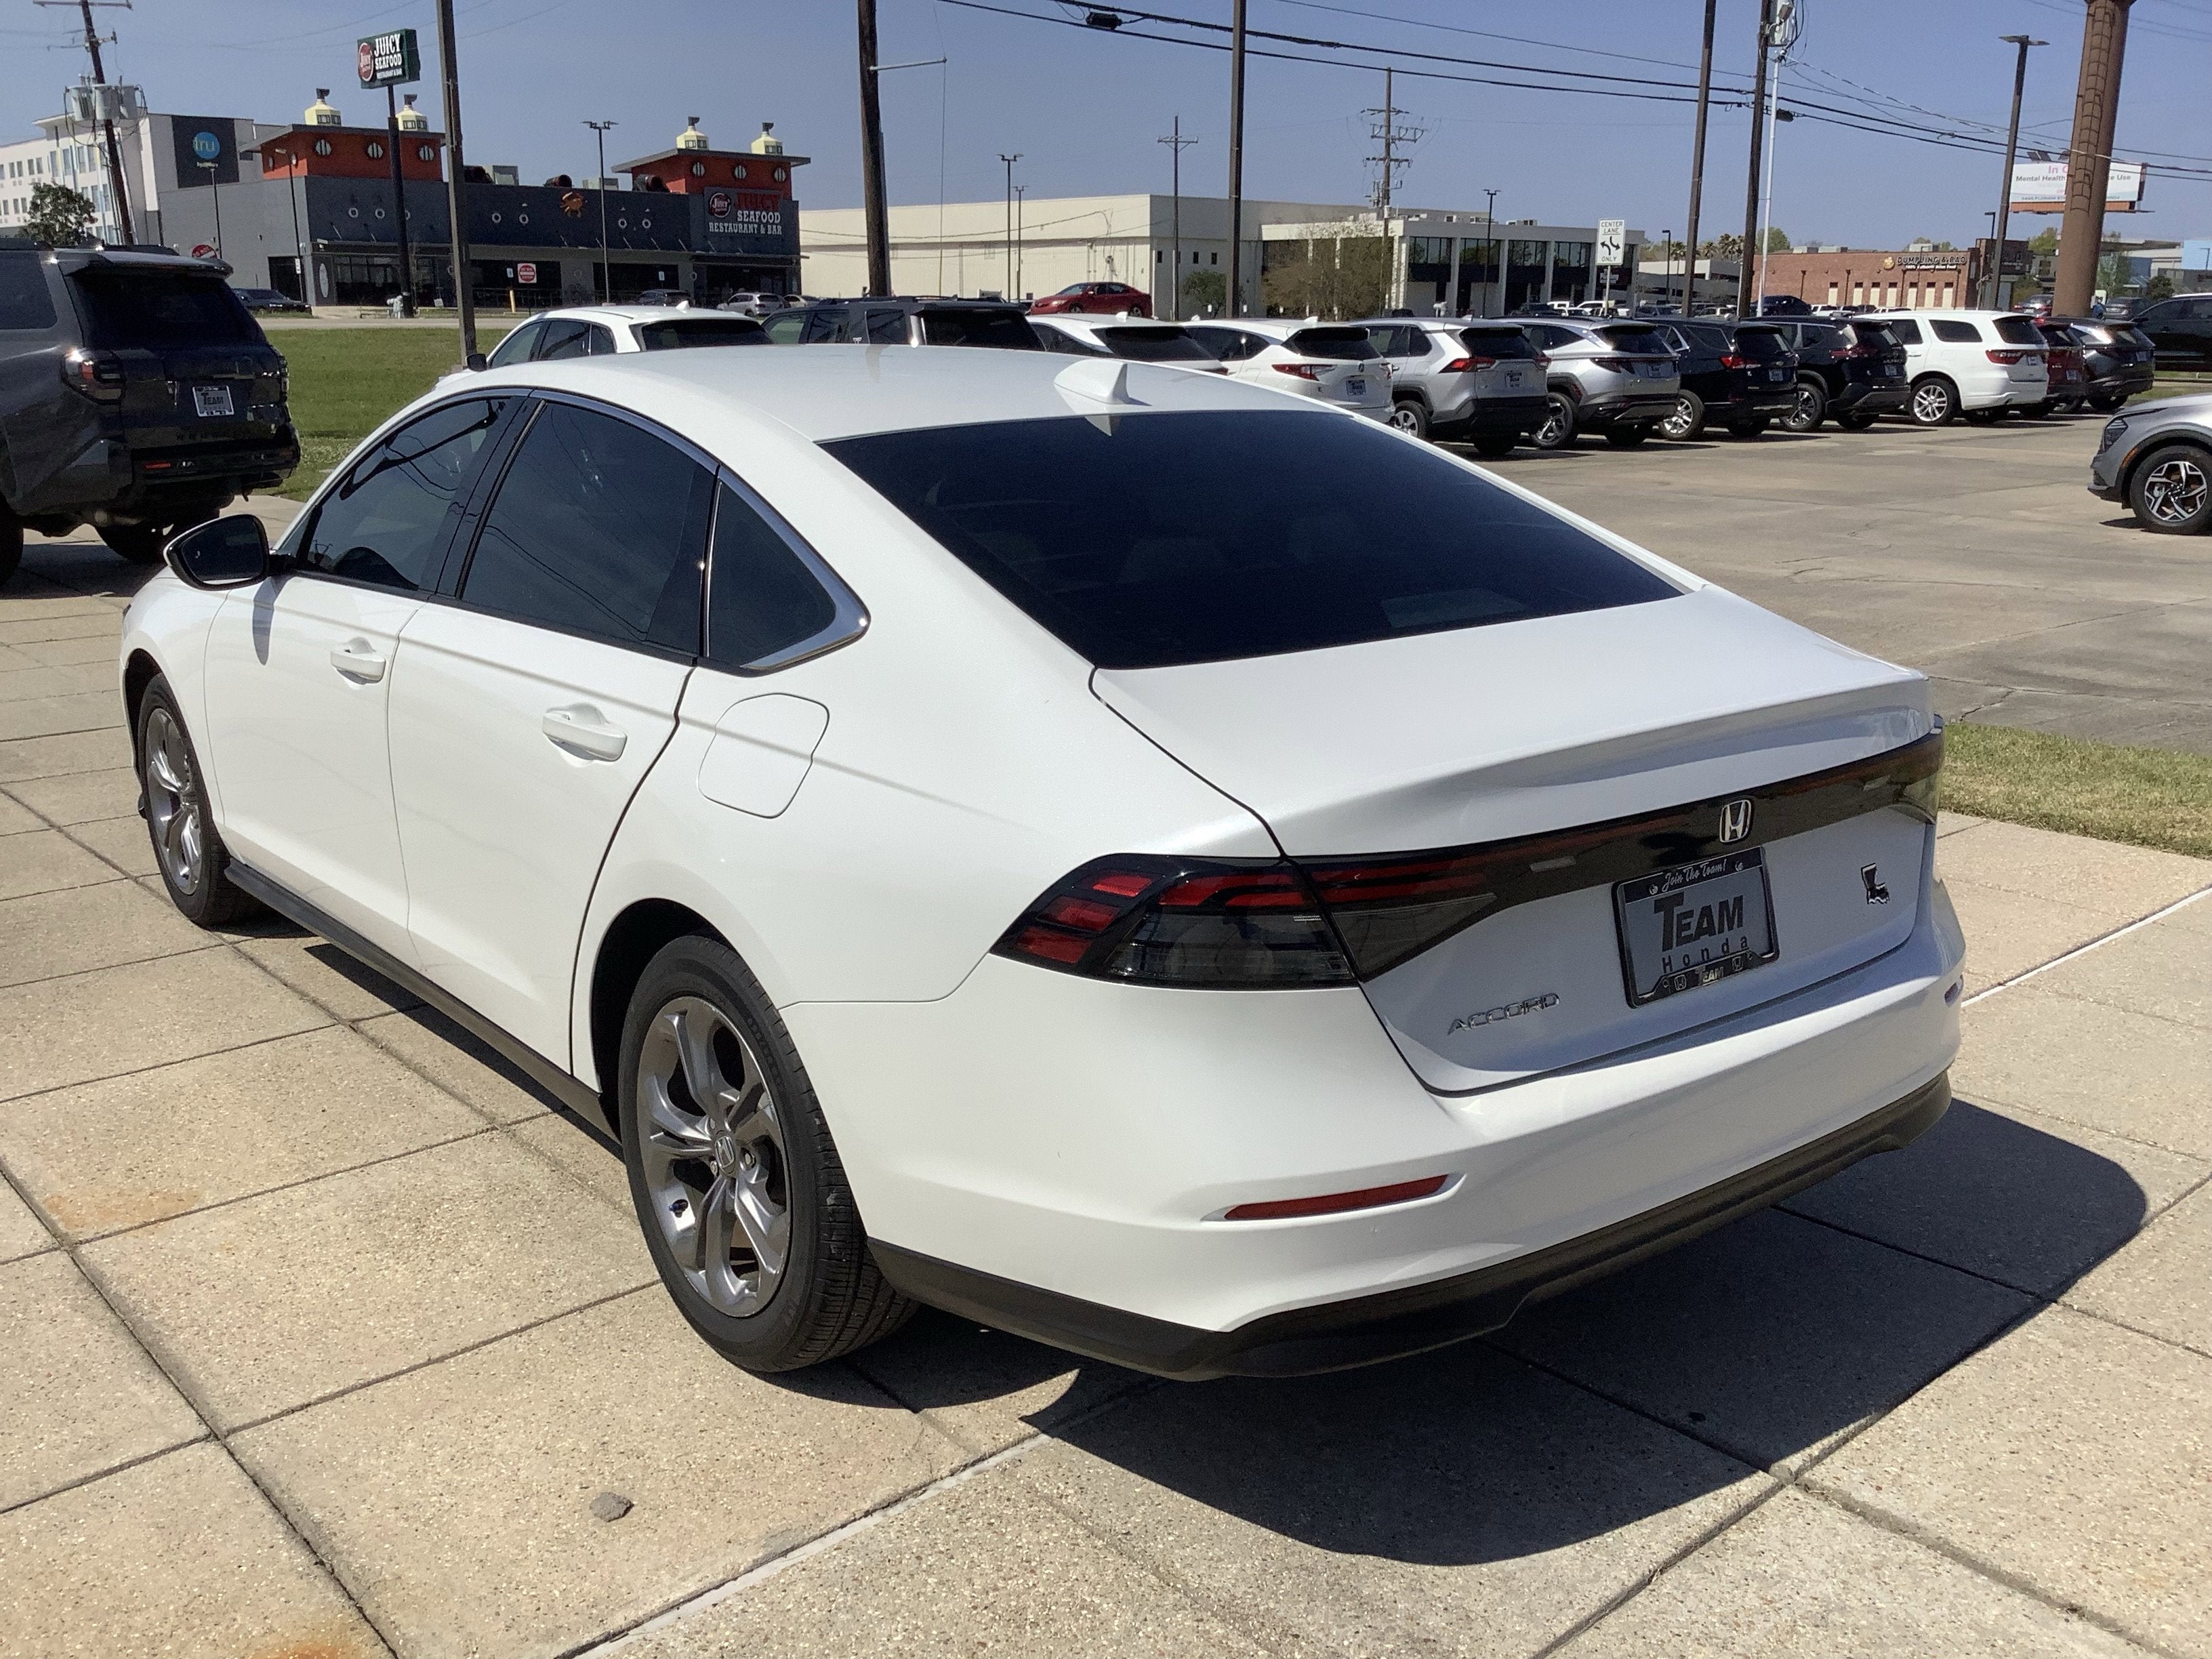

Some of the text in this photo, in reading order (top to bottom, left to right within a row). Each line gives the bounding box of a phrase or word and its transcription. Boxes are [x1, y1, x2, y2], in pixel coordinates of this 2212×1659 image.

[374, 33, 401, 57] JUICY
[375, 54, 402, 70] SEAFOOD
[2049, 165, 2058, 173] In
[737, 209, 781, 224] SEAFOOD
[709, 222, 782, 235] RESTAURANT & BAR
[1898, 256, 1939, 265] DUMPLING
[1948, 256, 1966, 265] BAO
[1661, 858, 1727, 892] Join The Team!
[1654, 891, 1744, 952] TEAM
[1662, 936, 1748, 974] Honda
[1695, 965, 1724, 985] TEAM
[1447, 992, 1560, 1036] ACCORD
